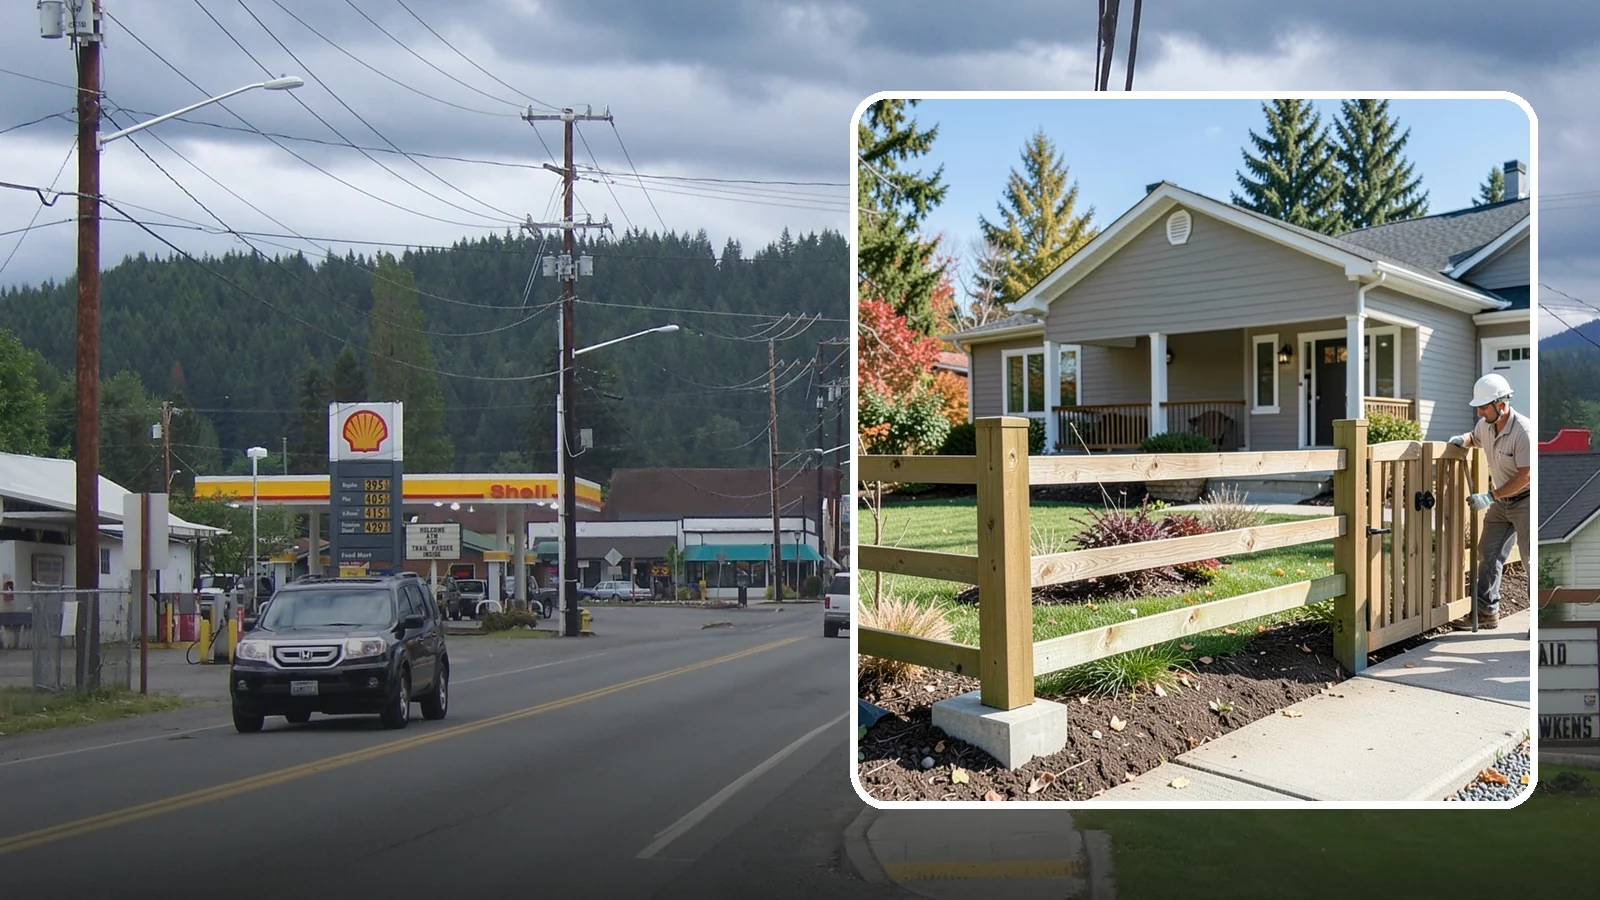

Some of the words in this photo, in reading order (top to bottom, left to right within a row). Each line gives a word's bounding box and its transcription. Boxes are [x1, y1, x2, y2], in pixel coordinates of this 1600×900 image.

[366, 480, 383, 490] 395
[490, 484, 547, 499] Shell
[366, 494, 383, 504] 405
[366, 508, 383, 518] 415
[366, 522, 383, 532] 429
